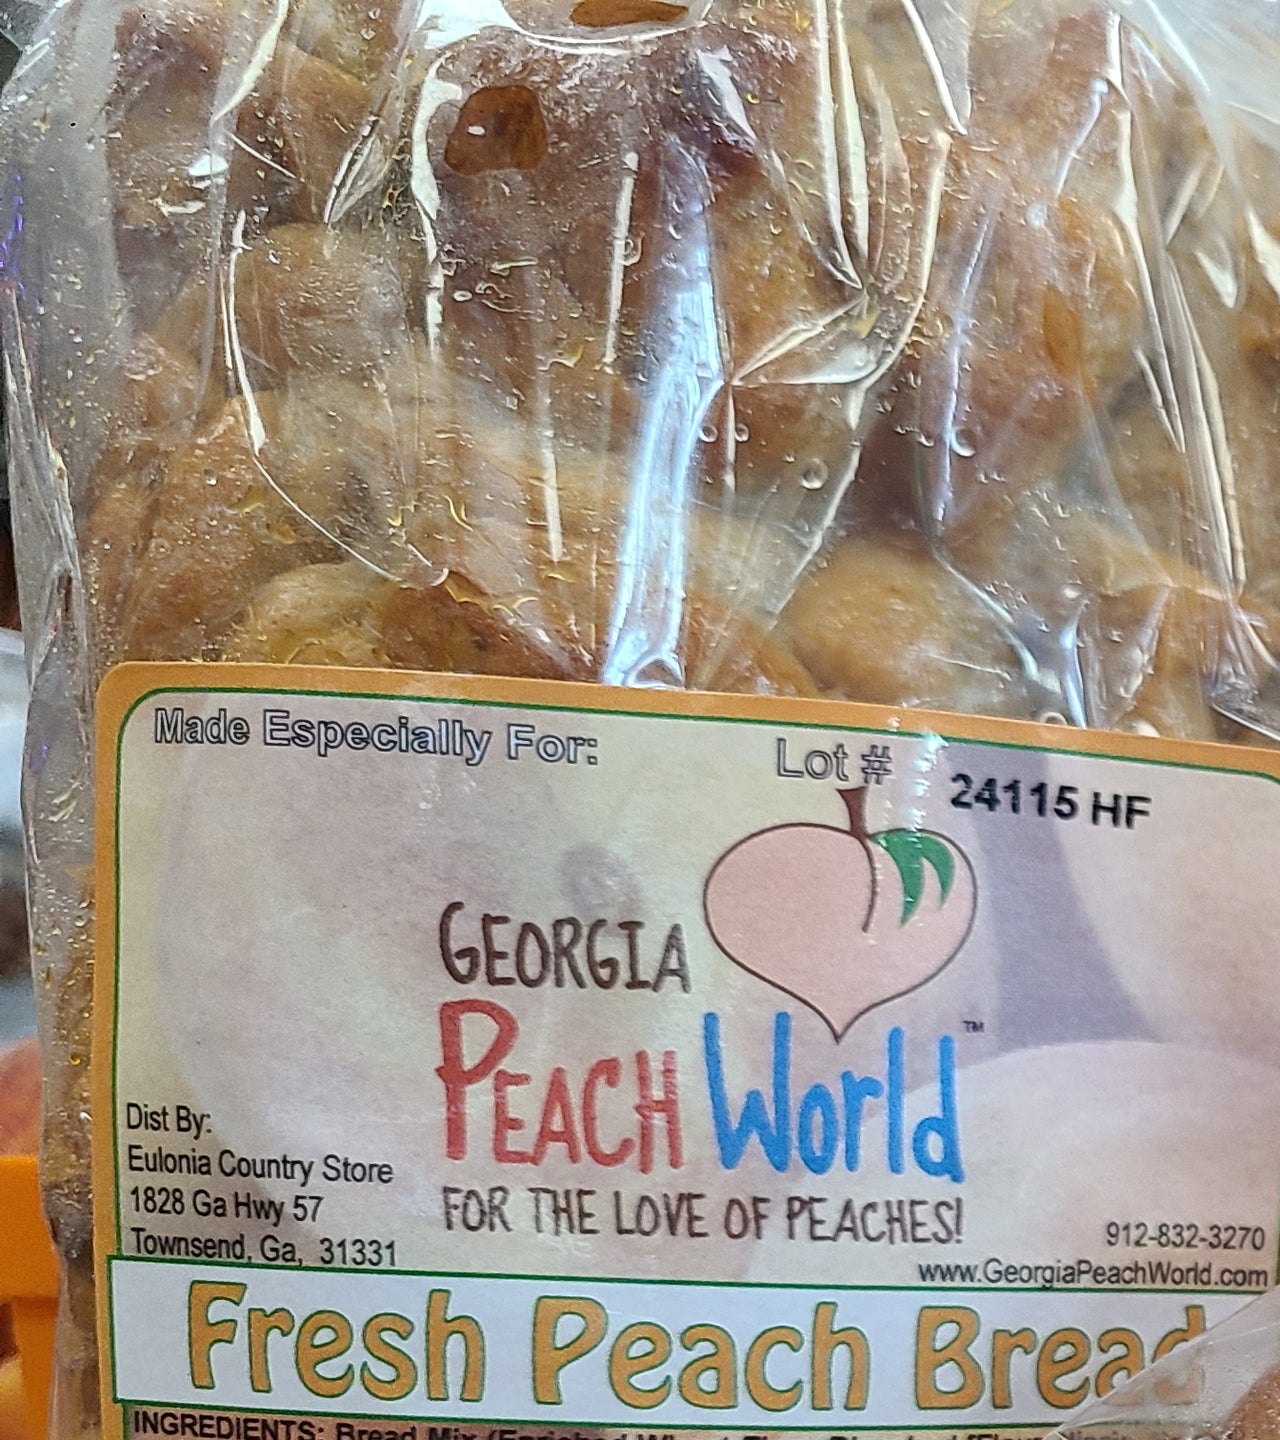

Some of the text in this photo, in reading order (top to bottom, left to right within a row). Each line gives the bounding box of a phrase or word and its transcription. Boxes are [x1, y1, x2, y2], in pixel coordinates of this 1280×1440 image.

[153, 707, 599, 768] Made Especially For:
[776, 737, 895, 784] Lot #
[949, 774, 1152, 831] 24115 HF
[440, 901, 691, 995] GEORGIA
[434, 999, 966, 1183] PEACH World
[126, 1102, 212, 1140] Dist By:
[128, 1145, 394, 1186] Eulonia Country Store
[130, 1186, 324, 1227] 1828 Ga Hwy 57
[442, 1186, 966, 1247] FOR THE LOVE OF PEACHES!
[130, 1227, 396, 1266] Townsend, Ga, 31331
[1106, 1221, 1265, 1251] 912-832-3270
[919, 1257, 1268, 1289] www.GeorgiaPeachWorld.com
[187, 1280, 486, 1400] Fresh
[532, 1295, 872, 1409] Peach
